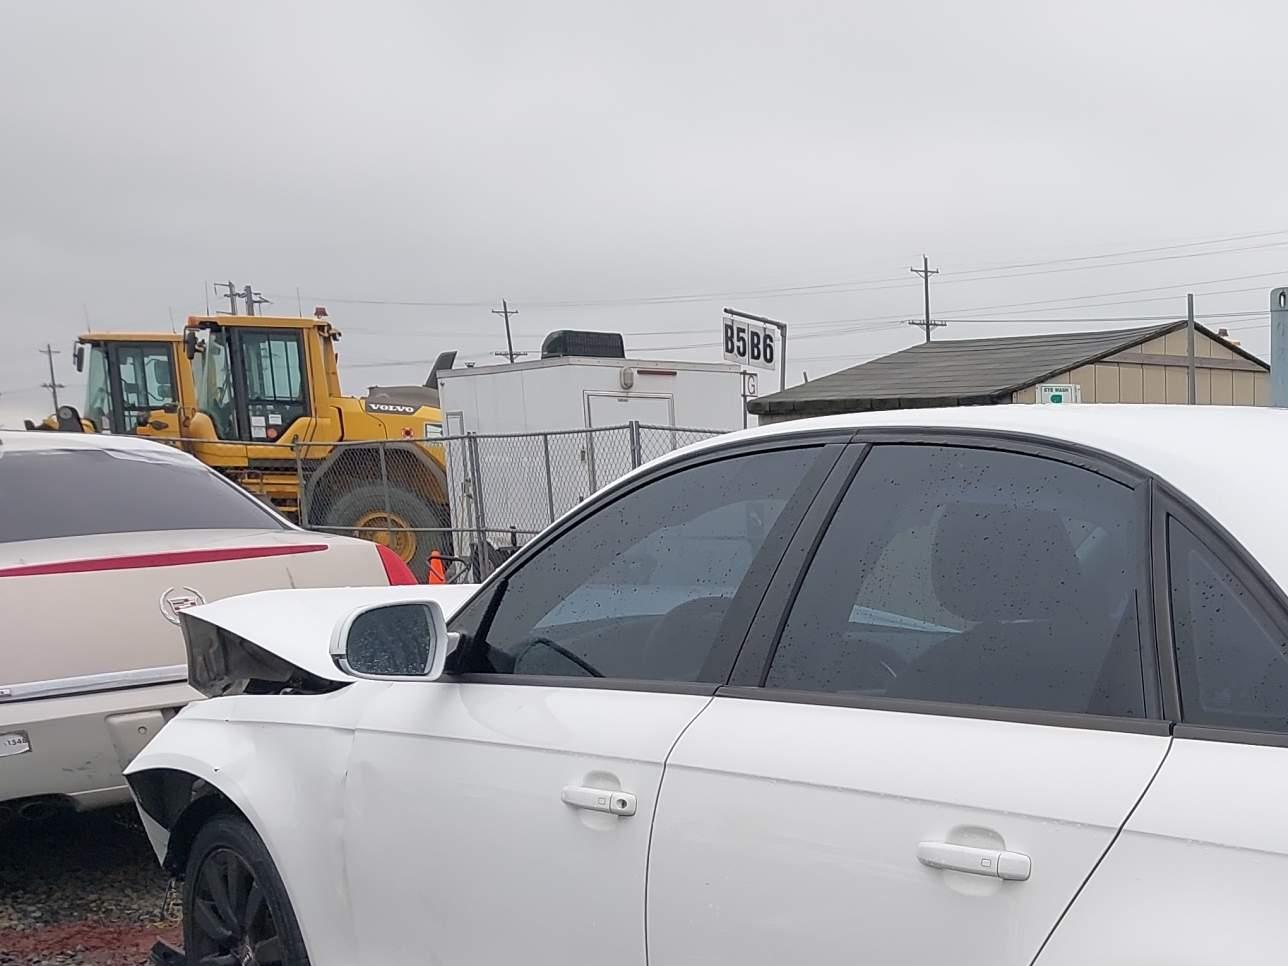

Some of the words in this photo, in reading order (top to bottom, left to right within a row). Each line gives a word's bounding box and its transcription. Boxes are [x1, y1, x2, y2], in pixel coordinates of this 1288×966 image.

[725, 323, 747, 357] B5
[750, 330, 774, 363] B6
[747, 375, 756, 395] G
[369, 403, 414, 413] VOLVO
